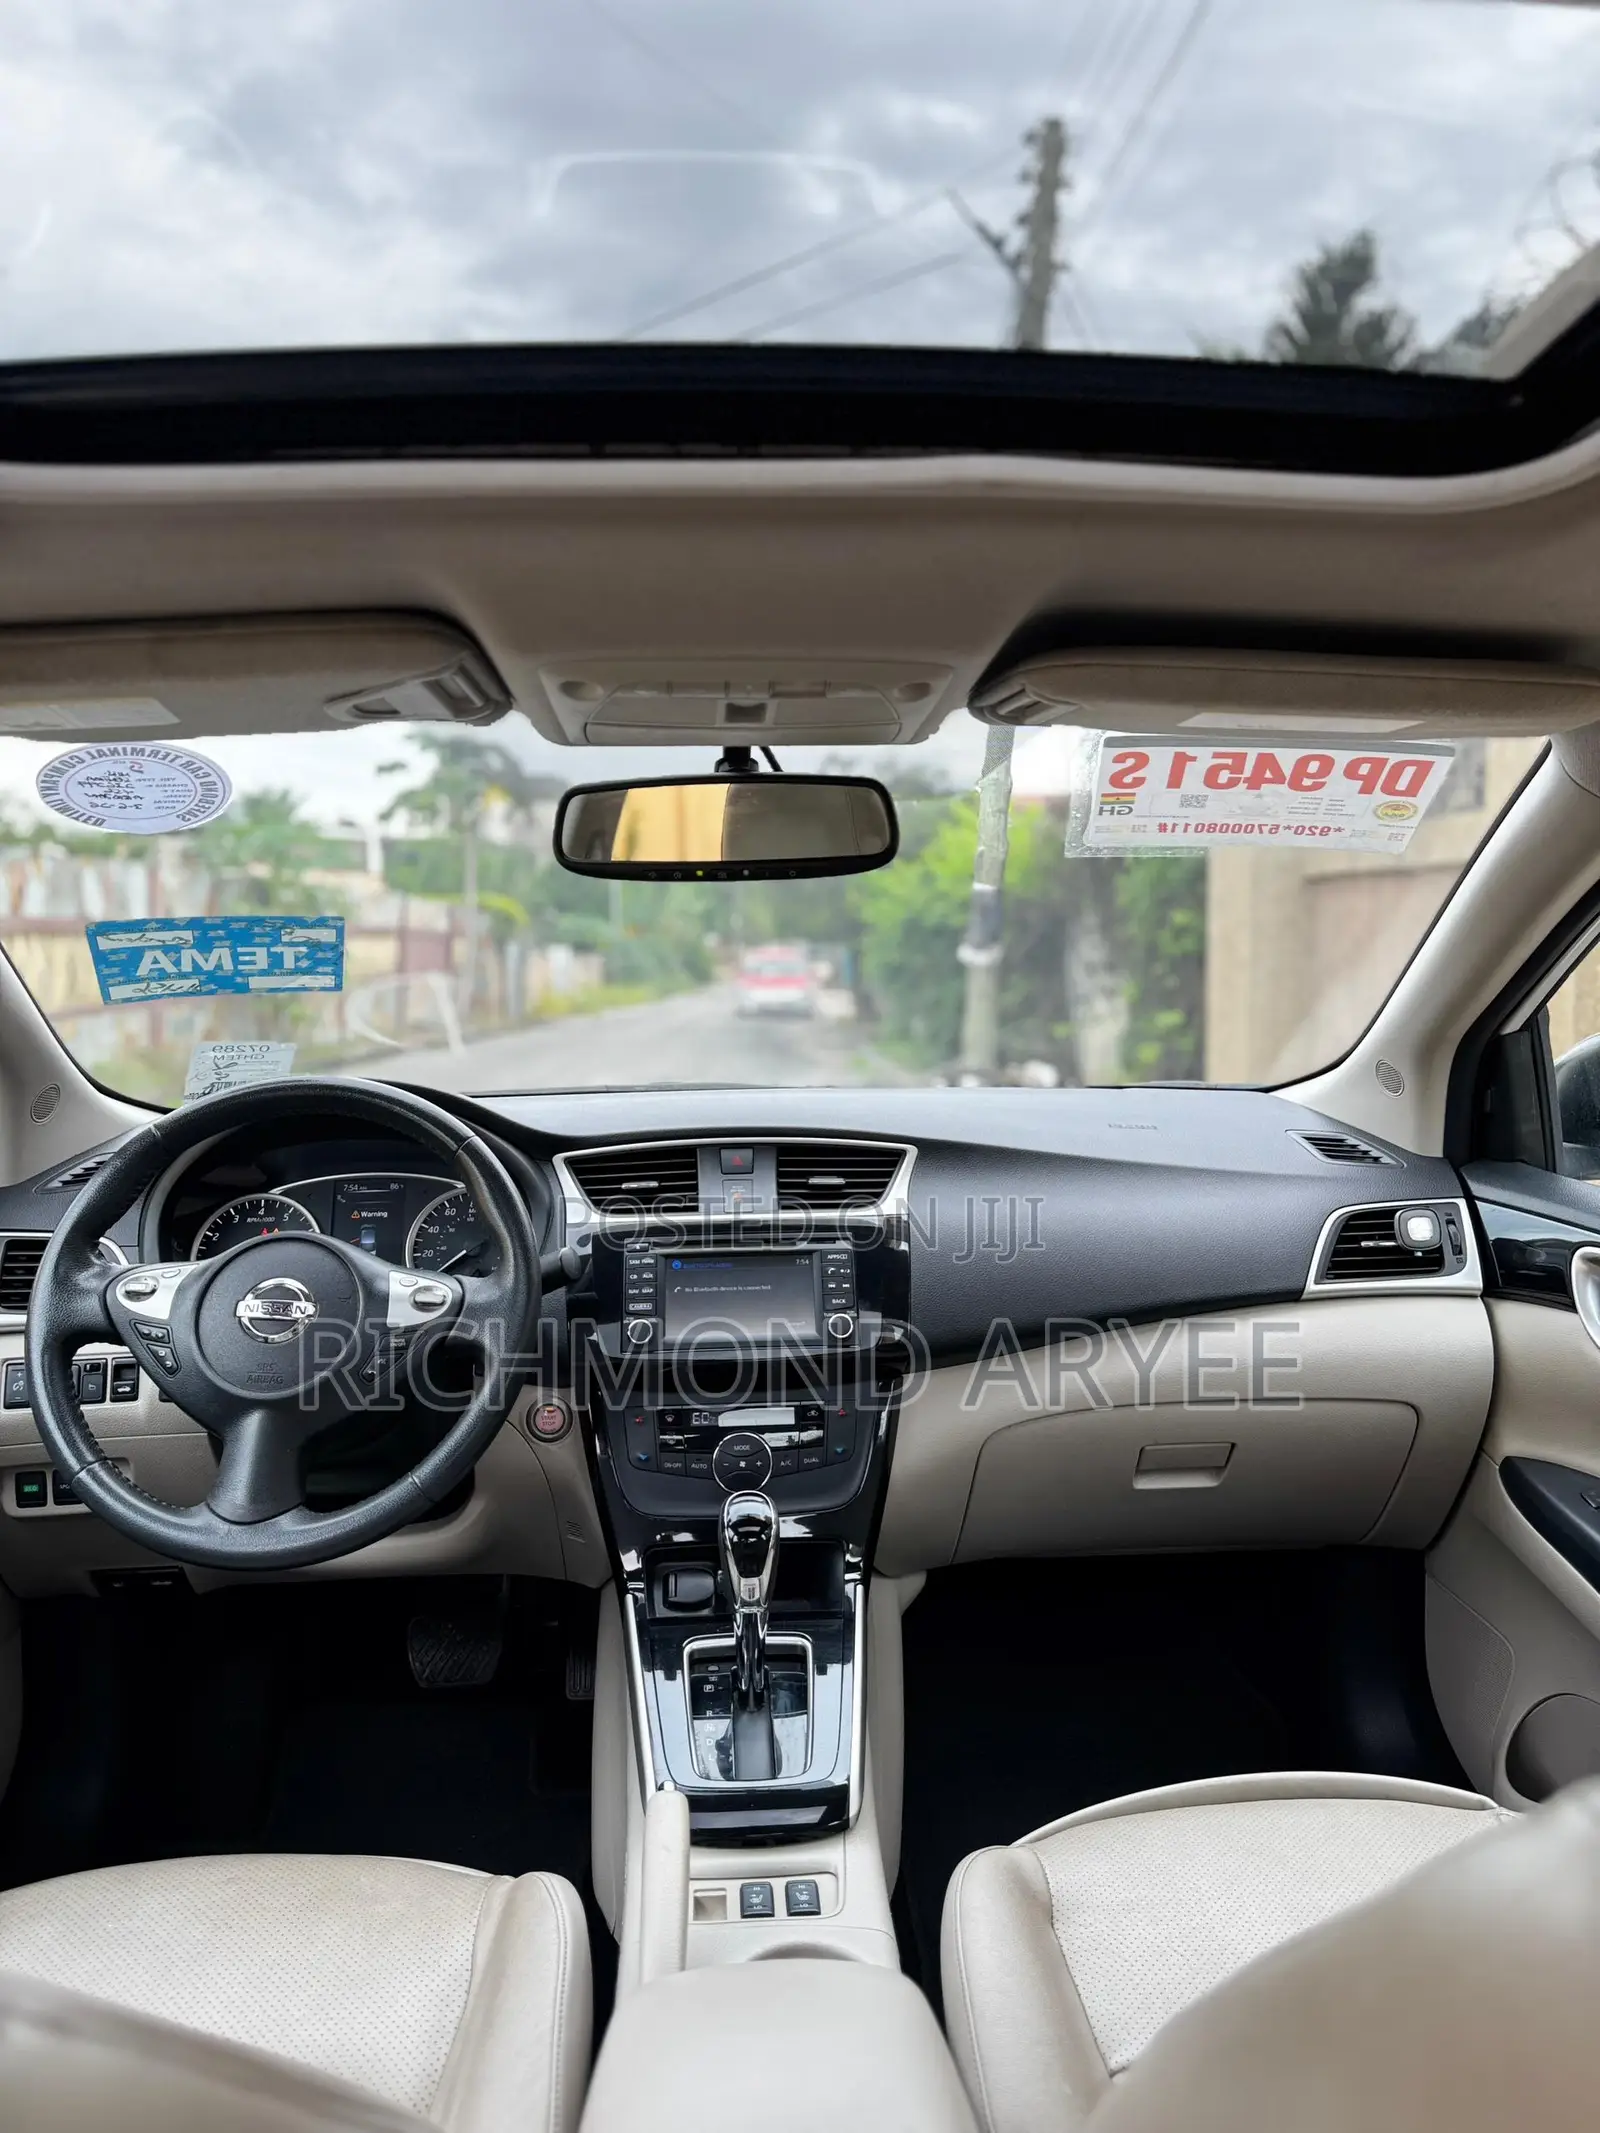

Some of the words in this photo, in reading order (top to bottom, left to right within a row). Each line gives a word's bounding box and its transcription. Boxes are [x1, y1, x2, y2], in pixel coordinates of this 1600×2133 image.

[258, 1207, 265, 1216] 4
[360, 1210, 388, 1219] Warning
[444, 1208, 456, 1216] 60
[233, 1214, 240, 1223] 3
[283, 1213, 289, 1222] 5
[428, 1226, 440, 1234] 40
[212, 1232, 220, 1241] 2
[422, 1249, 434, 1258] 20
[244, 1301, 307, 1315] NISSAN
[246, 1374, 284, 1385] AIRBAG
[706, 1738, 714, 1746] D
